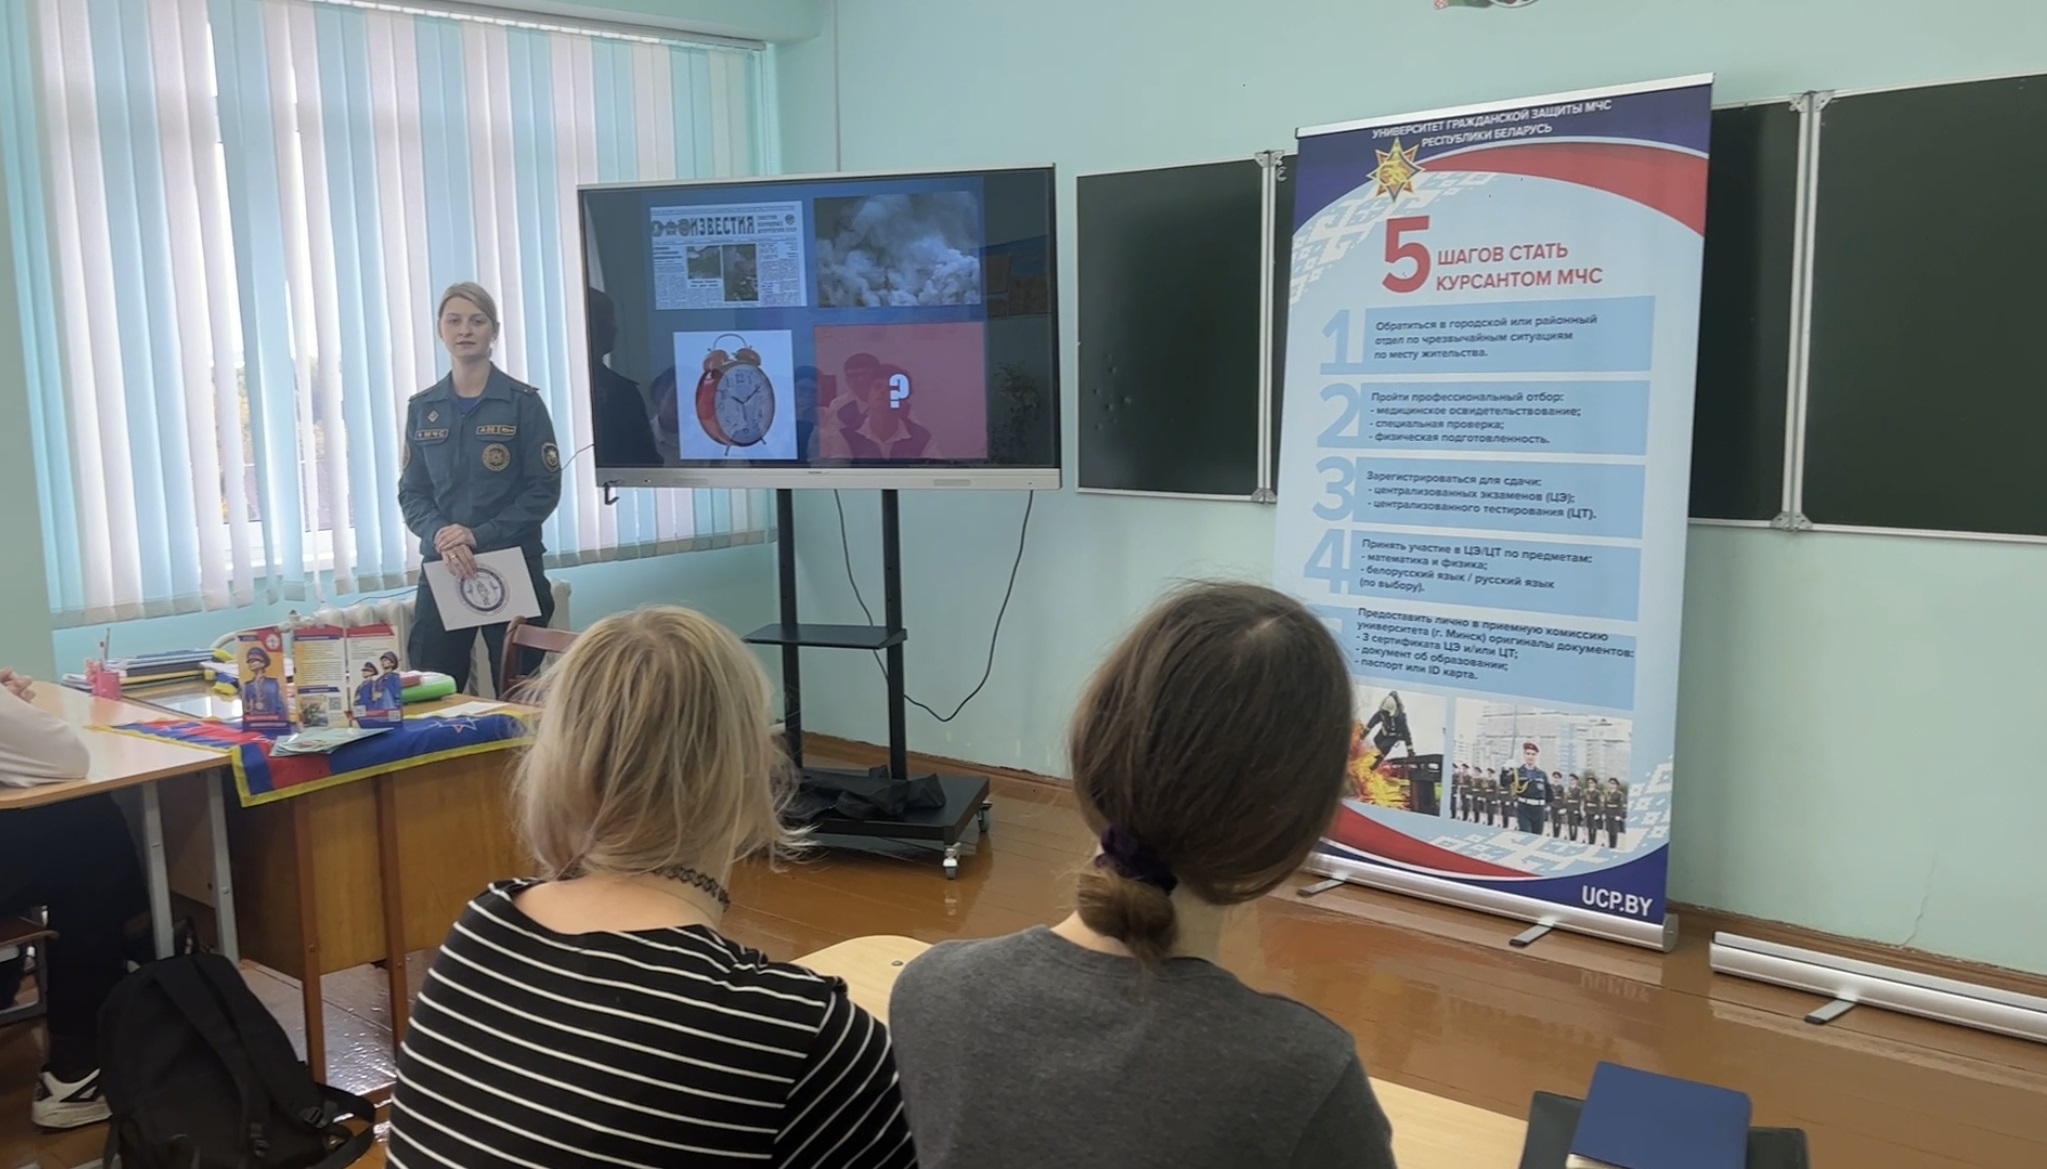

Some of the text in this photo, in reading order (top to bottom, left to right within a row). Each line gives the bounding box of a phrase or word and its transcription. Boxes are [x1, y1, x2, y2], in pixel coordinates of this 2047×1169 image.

[1371, 99, 1612, 139] УНИВЕРСИТЕТ ГРАЖДАНСКОЙ ЗАЩИТЫ МЧС
[1421, 123, 1553, 147] РЕСПУБЛИКИ БЕЛАРУСЬ
[690, 215, 754, 236] ИЗВЕСТИЯ
[1382, 215, 1431, 293] 5
[1438, 243, 1569, 266] ШАГОВ СТАТЬ
[1436, 267, 1603, 291] КУРСАНТОМ МЧС
[1375, 314, 1598, 332] Обратиться в городской или районный
[1374, 332, 1573, 346] отдел по чрезвычайным ситуациям
[1374, 349, 1489, 361] по месту жительства.
[888, 372, 910, 409] ?
[1371, 392, 1565, 403] Пройти профессиональный отбор:
[1317, 382, 1361, 448] 2
[1376, 407, 1447, 415] медицинское
[1449, 407, 1582, 417] освидетельствование;
[1375, 420, 1444, 429] специальная
[1446, 421, 1505, 430] проверка;
[1374, 432, 1439, 442] физическая
[1441, 434, 1550, 444] подготовленность.
[1312, 456, 1355, 521] 3
[1366, 471, 1542, 487] Зарегистрироваться для сдачи:
[1374, 487, 1478, 498] централизованных
[1480, 491, 1543, 501] экзаменов
[1373, 501, 1481, 513] централизованного
[1483, 505, 1565, 517] тестирования
[1566, 508, 1597, 521] (ЦТ).
[1304, 528, 1350, 595] 4
[1361, 538, 1593, 563] Принять участие в ЦЭ/ЦТ по предметам:
[1367, 554, 1429, 566] математика
[1441, 558, 1488, 571] физика;
[1359, 577, 1425, 593] (по выбору).
[1366, 565, 1435, 579] белорусский
[1437, 572, 1465, 582] язык
[1475, 575, 1522, 586] русский
[1524, 579, 1555, 589] язык
[1358, 607, 1609, 641] Предоставить лично в приемную комиссию
[1357, 621, 1429, 636] университета
[1431, 628, 1443, 638] (г.
[1445, 628, 1487, 643] Минск)
[1489, 635, 1555, 649] оригиналы
[1556, 642, 1635, 658] документов:
[1362, 632, 1370, 641] 3
[1371, 634, 1441, 650] сертификата
[1443, 641, 1461, 652] ЦЭ
[1463, 644, 1496, 656] и/или
[1498, 647, 1518, 660] ЦТ;
[1360, 658, 1403, 671] паспорт
[1405, 663, 1426, 674] или
[1428, 664, 1440, 675] ID
[1443, 669, 1478, 680] карта.
[1361, 646, 1412, 659] документ
[1414, 651, 1428, 661] об
[1430, 653, 1509, 672] образовании;
[1582, 884, 1654, 917] UCP.BY
